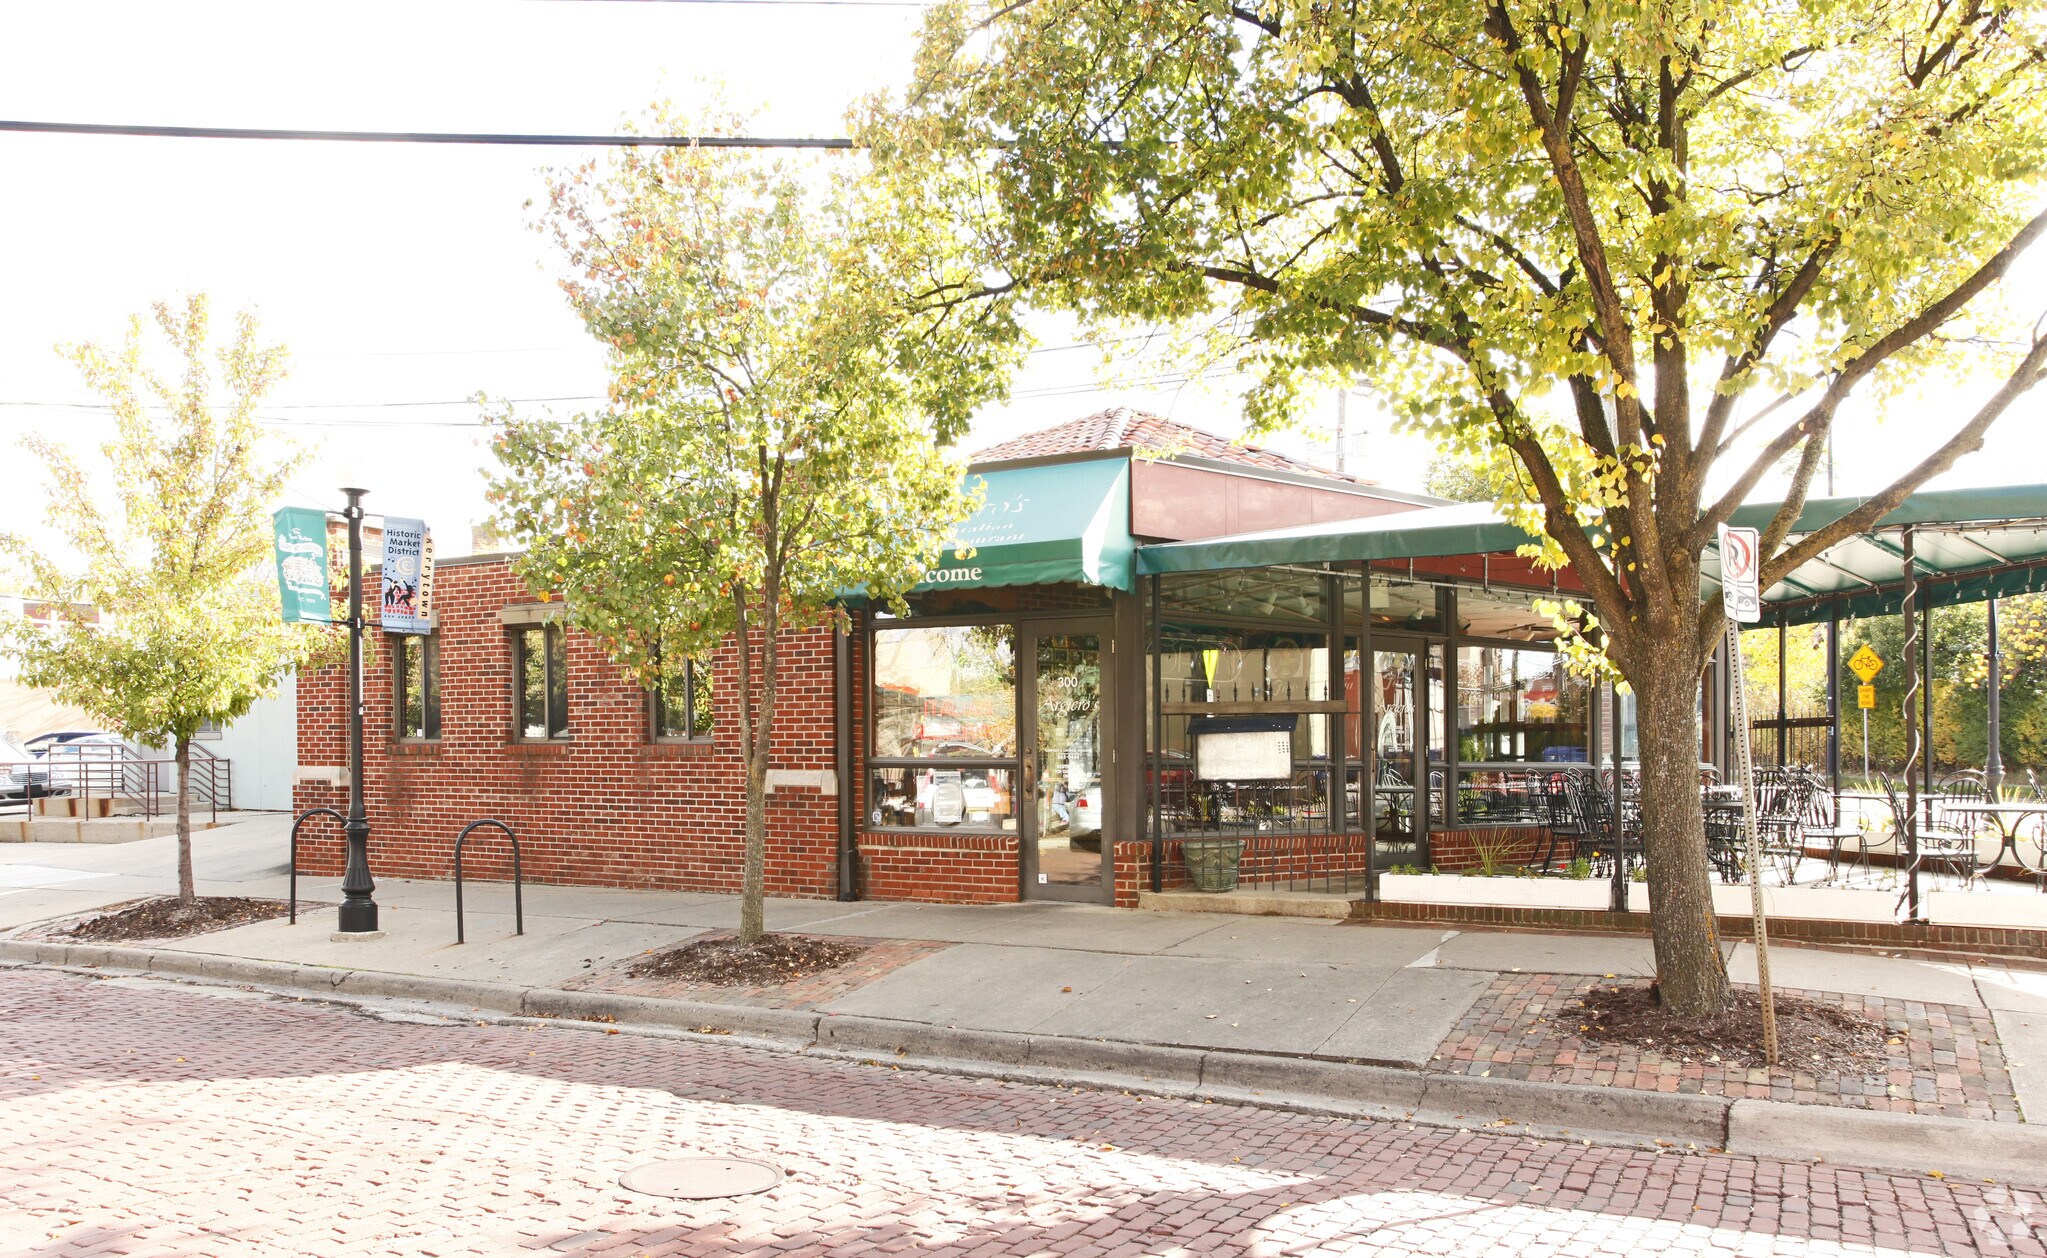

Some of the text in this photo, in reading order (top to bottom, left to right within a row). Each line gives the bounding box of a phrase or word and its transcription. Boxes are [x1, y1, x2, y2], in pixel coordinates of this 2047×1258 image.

[387, 529, 421, 539] Historic
[390, 538, 420, 548] Market
[388, 546, 419, 556] District
[421, 537, 433, 617] kerrytown
[1058, 676, 1078, 688] 300
[1037, 695, 1099, 717] Argiero's
